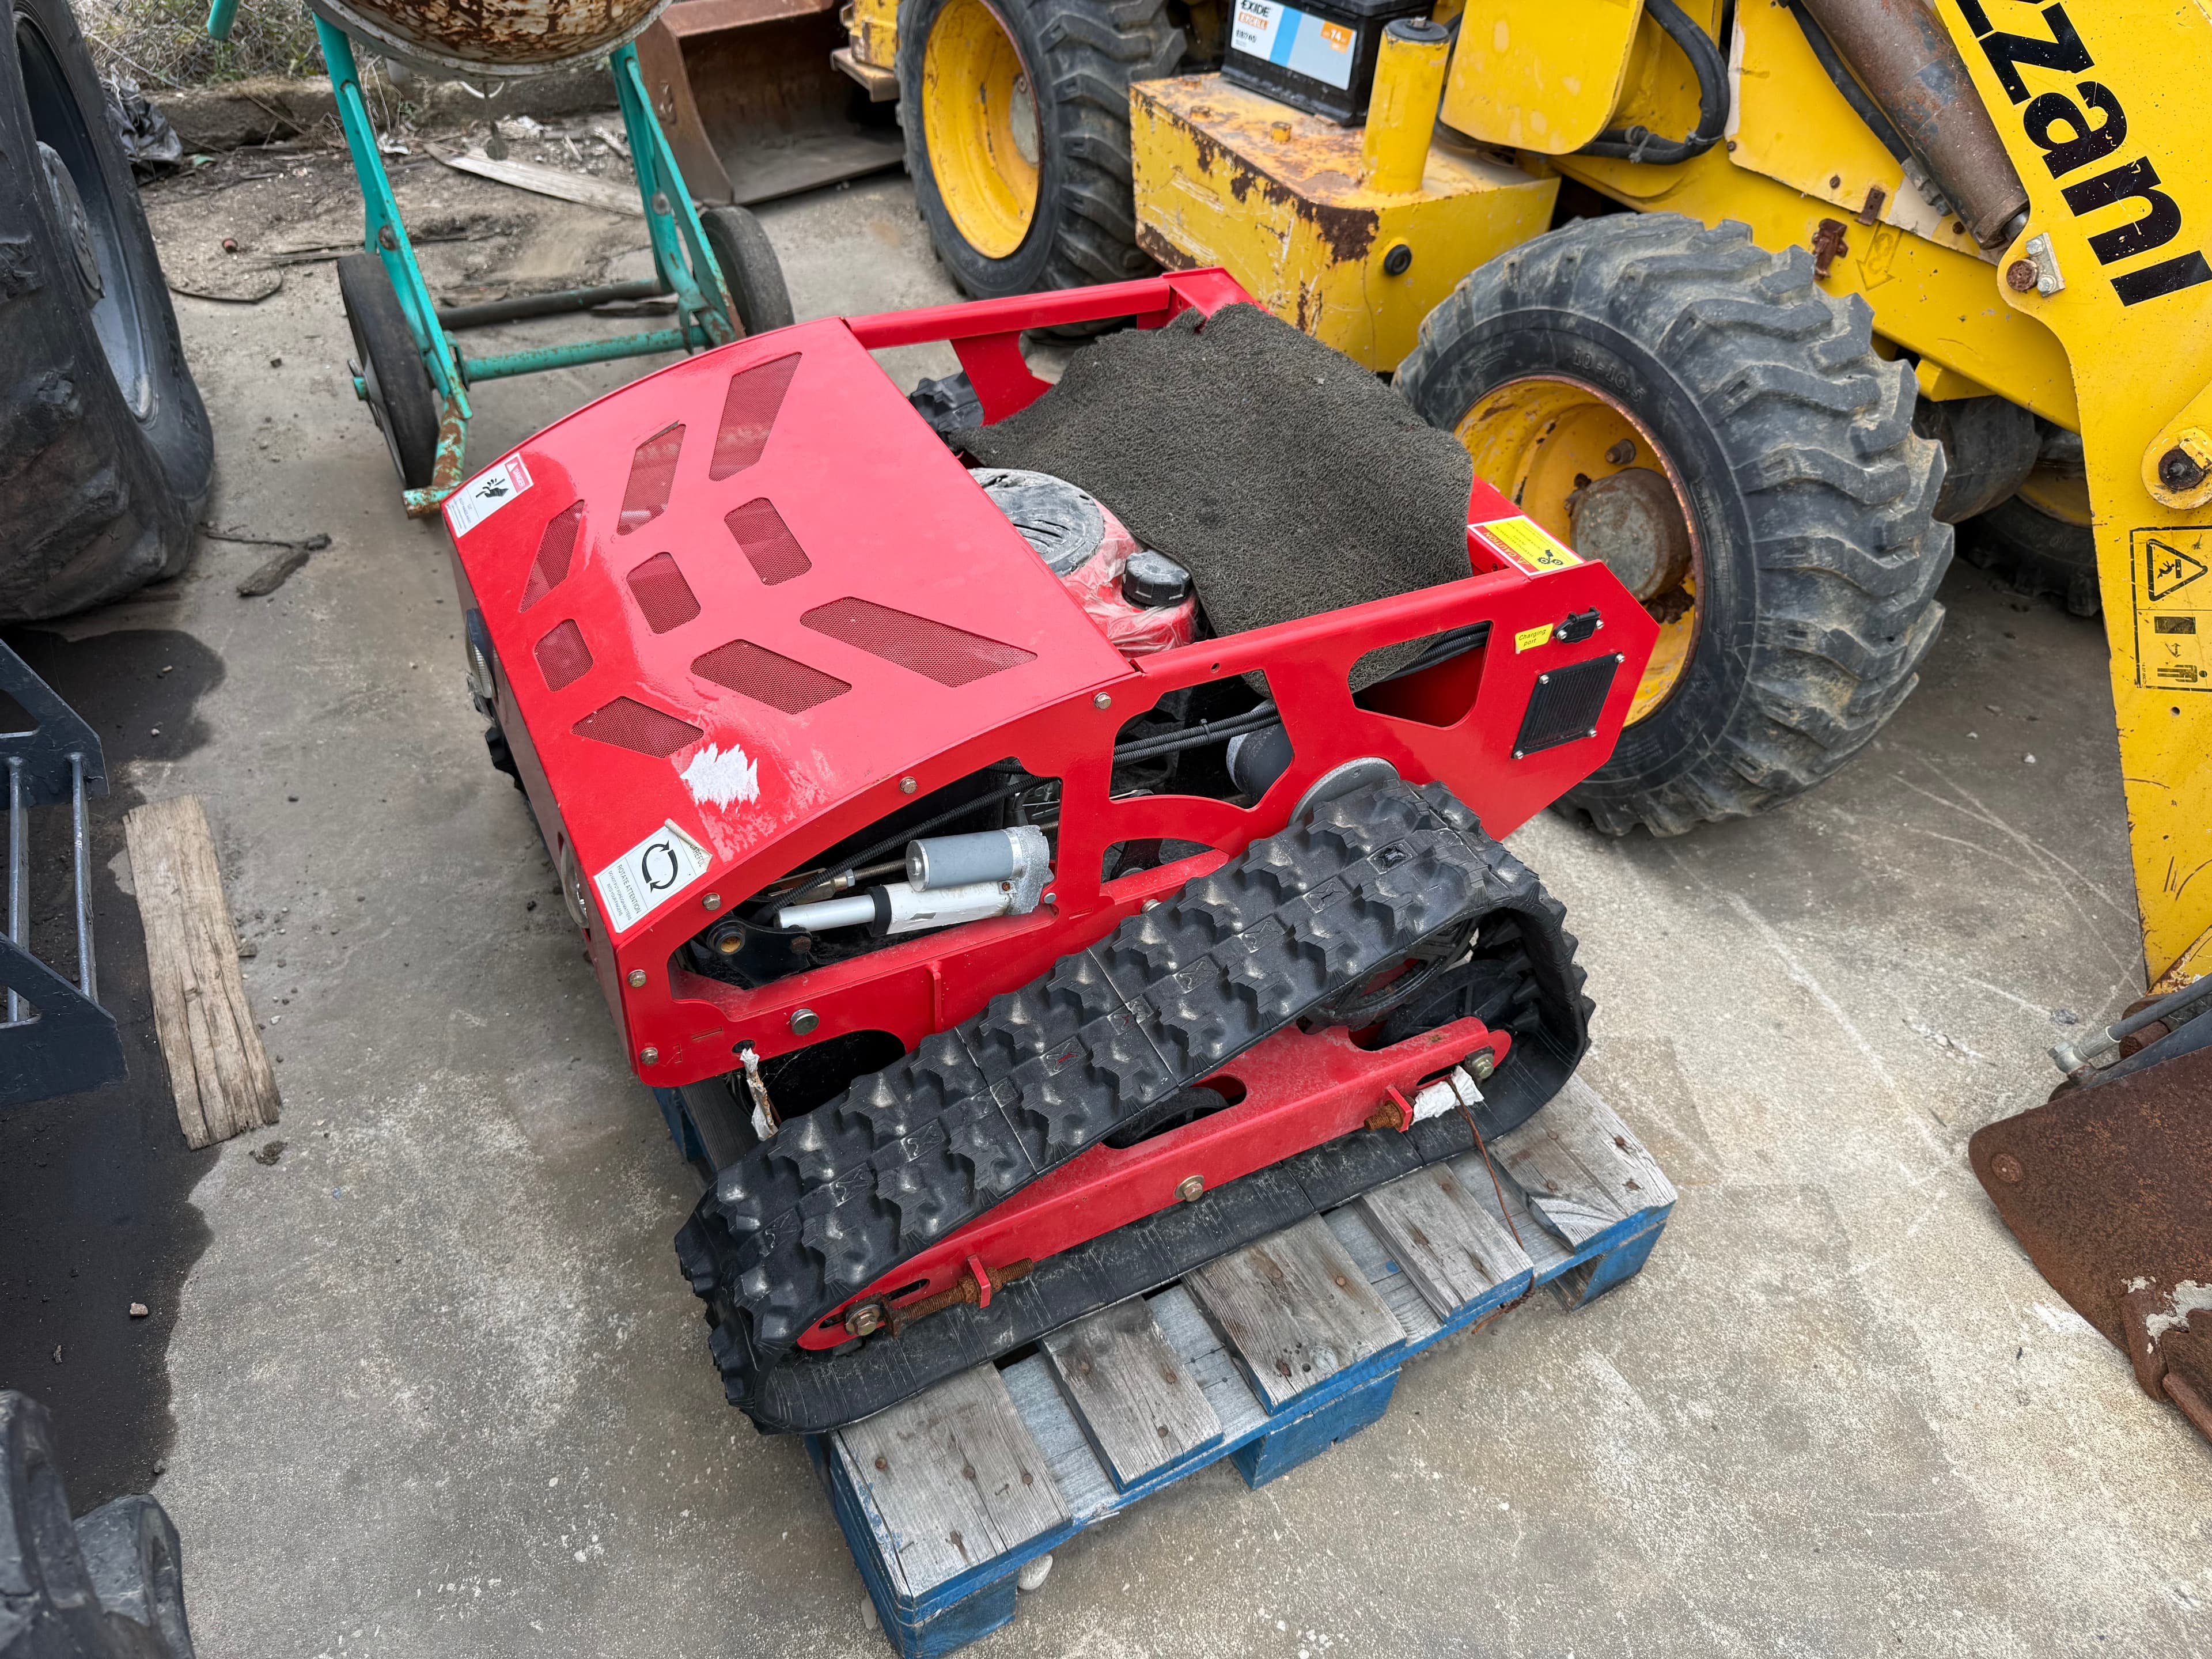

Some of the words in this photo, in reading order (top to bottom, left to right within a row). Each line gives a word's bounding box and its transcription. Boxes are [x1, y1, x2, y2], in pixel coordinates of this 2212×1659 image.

[1240, 0, 1270, 18] EXIDE
[1955, 0, 2212, 307] zani
[512, 468, 526, 489] DANGER
[1483, 531, 1517, 557] CAUTION
[1518, 628, 1547, 641] Charging
[1523, 638, 1536, 647] port
[617, 864, 629, 885] ROTATE
[625, 884, 641, 914] ATTENTION
